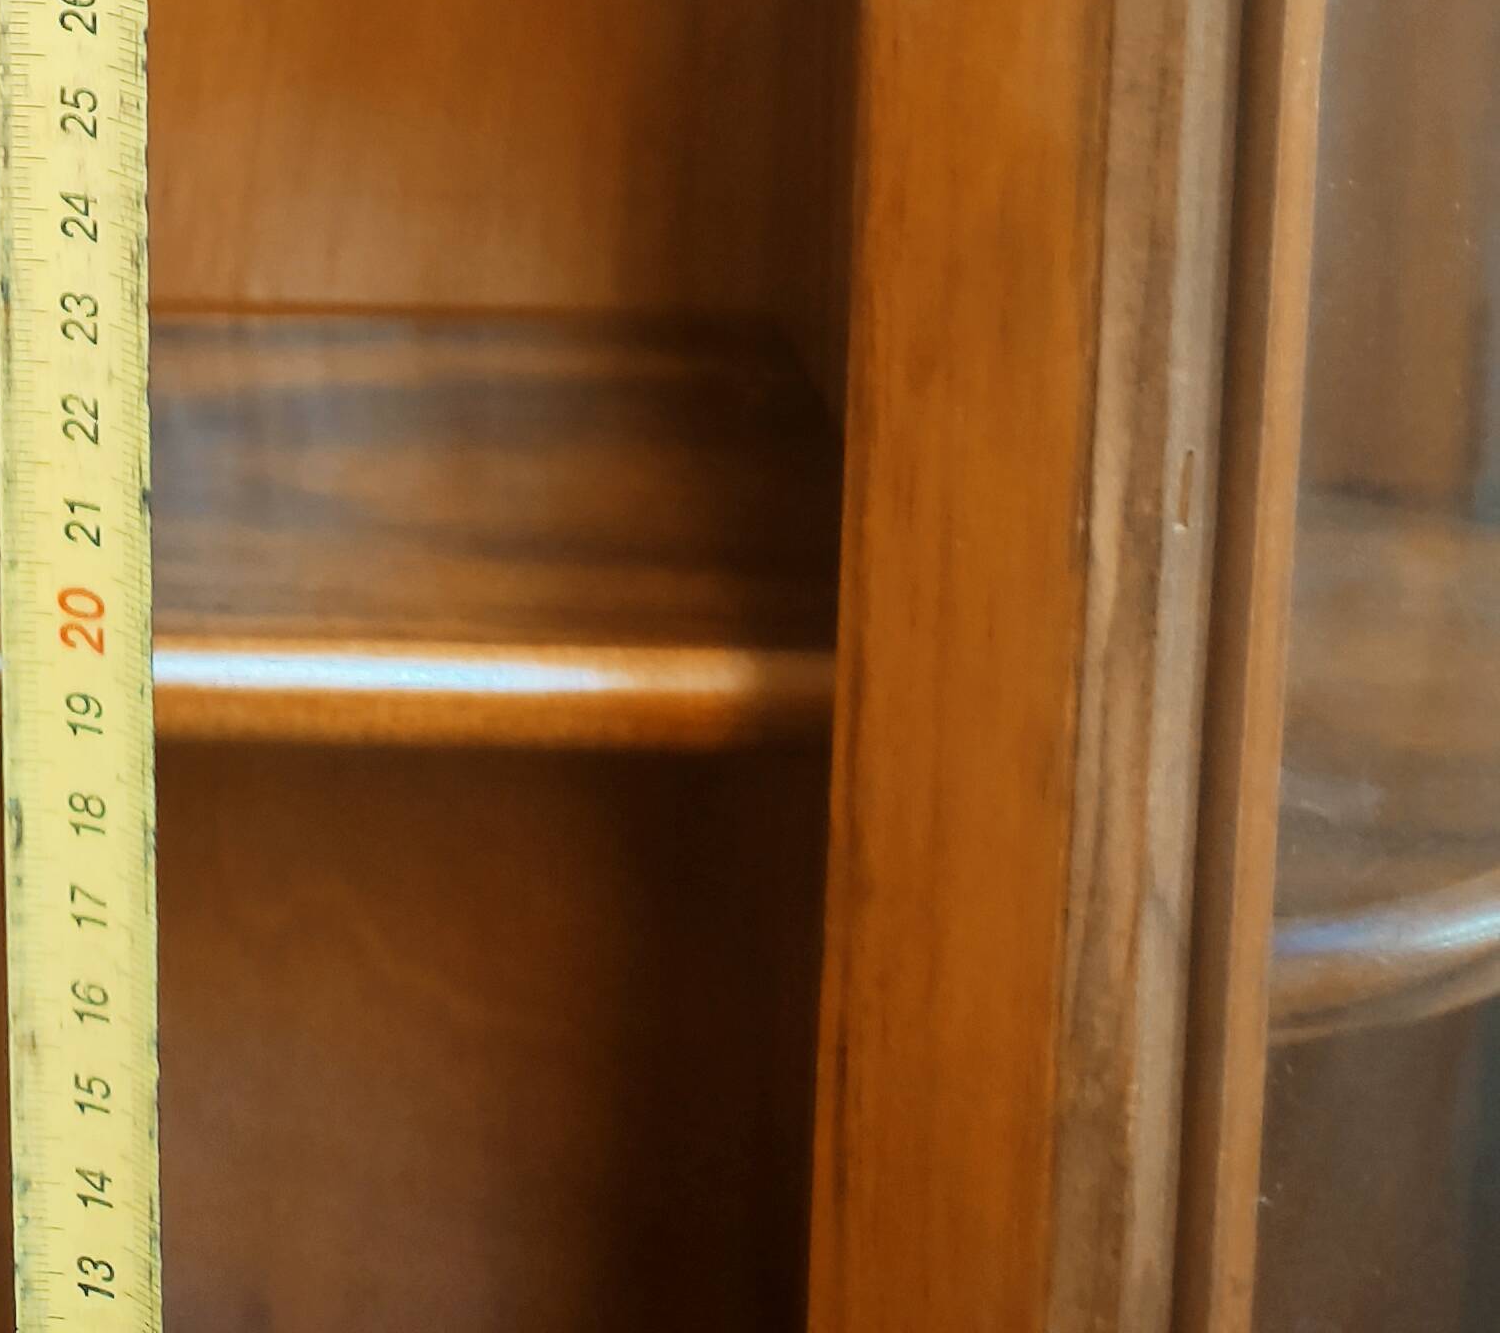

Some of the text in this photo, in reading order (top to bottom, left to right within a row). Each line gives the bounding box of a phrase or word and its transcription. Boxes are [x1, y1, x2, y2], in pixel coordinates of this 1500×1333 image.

[59, 86, 98, 140] 25
[59, 192, 99, 244] 24
[59, 292, 99, 346] 23
[60, 393, 100, 446] 22
[63, 498, 102, 548] 21
[57, 587, 106, 657] 20
[64, 692, 104, 737] 19
[67, 792, 107, 837] 18
[69, 883, 108, 929] 17
[70, 980, 111, 1024] 16
[73, 1073, 112, 1115] 15
[75, 1167, 114, 1209] 14
[76, 1255, 115, 1299] 13
